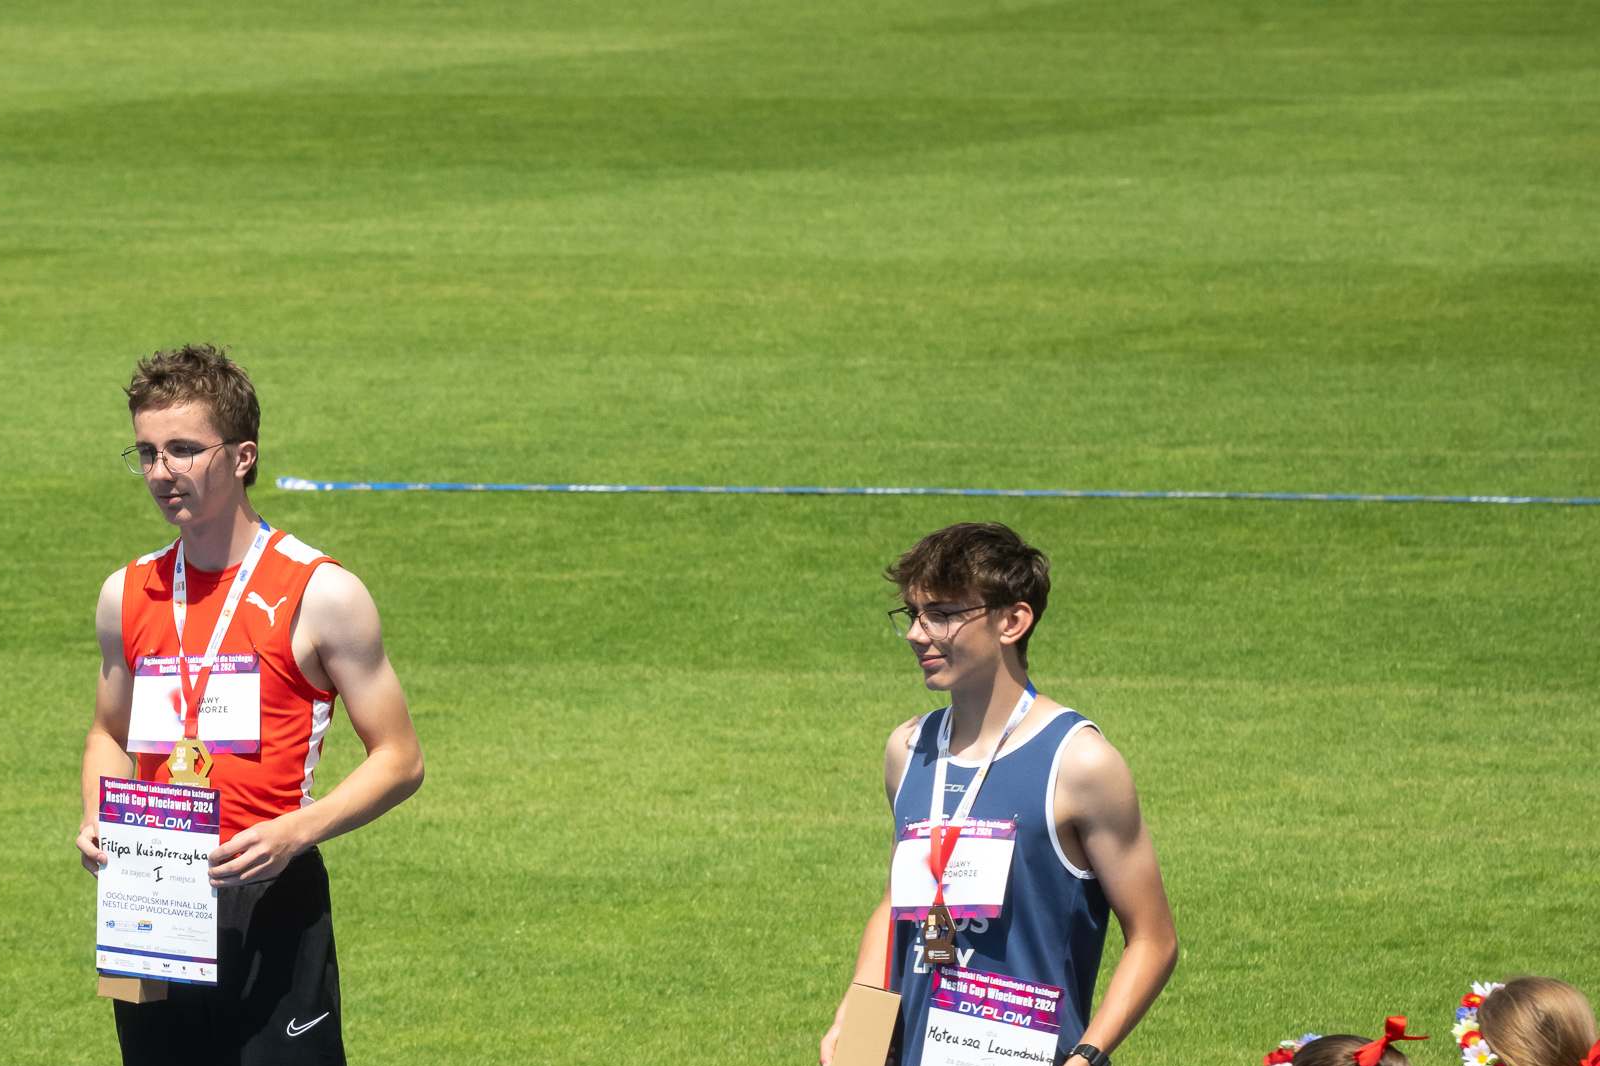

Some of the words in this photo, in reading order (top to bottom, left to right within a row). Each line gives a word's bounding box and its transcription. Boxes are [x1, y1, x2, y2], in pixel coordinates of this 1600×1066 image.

[105, 780, 135, 790] Ogólnopolski
[944, 784, 967, 792] COL
[106, 791, 129, 804] Nestlé
[132, 795, 146, 807] Cup
[148, 796, 191, 811] Włocławek
[193, 801, 213, 813] 2024
[124, 812, 191, 829] DYPLOM
[101, 838, 130, 858] Filipa
[130, 869, 151, 878] zajęcie
[170, 875, 196, 883] miejsca
[106, 891, 168, 907] OGÓLNOPOLSKIM
[171, 900, 190, 908] FINAŁ
[130, 903, 144, 911] CUP
[146, 906, 194, 918] WŁOCŁAWEK
[941, 978, 967, 993] Nestlé
[969, 984, 986, 998] Cup
[987, 987, 1033, 1007] Włocławek
[1035, 998, 1056, 1012] 2024
[959, 1001, 1032, 1026] DYPLOM
[986, 1030, 997, 1038] dla
